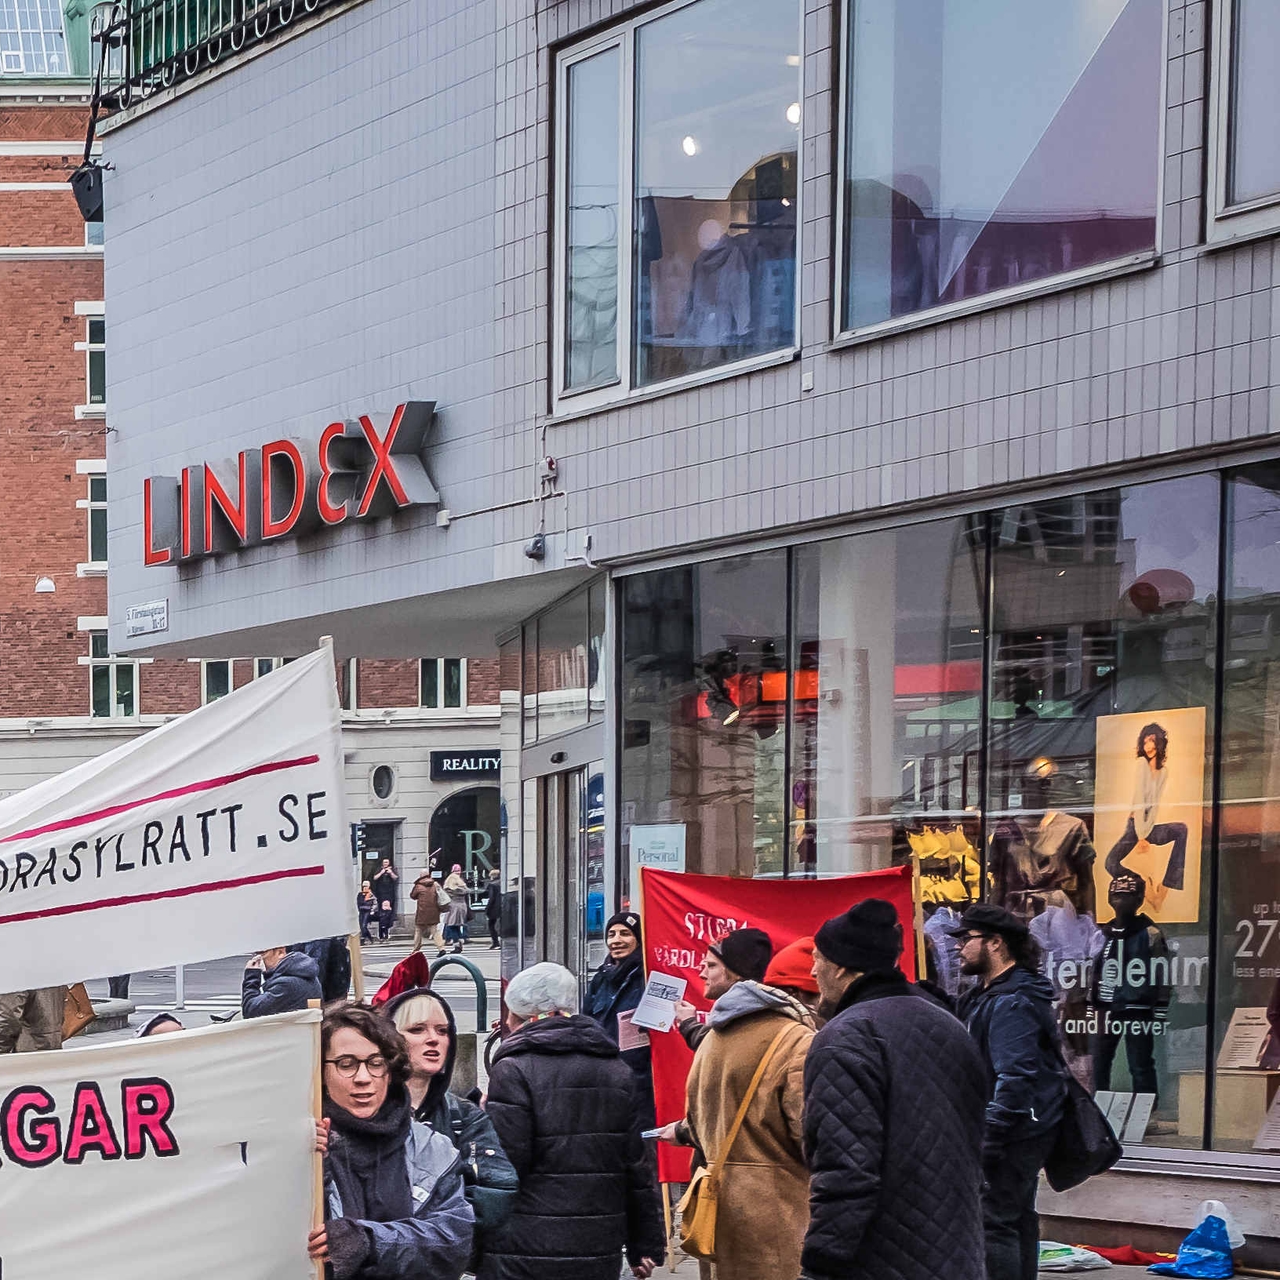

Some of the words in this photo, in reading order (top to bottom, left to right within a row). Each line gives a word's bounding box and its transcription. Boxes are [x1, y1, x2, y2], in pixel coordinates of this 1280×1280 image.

[143, 402, 410, 567] LINDEX
[442, 757, 501, 770] REALITY
[637, 847, 679, 863] Personal
[1253, 904, 1269, 918] up
[1234, 920, 1280, 958] 27
[1102, 939, 1209, 987] denim
[1065, 1010, 1098, 1034] and
[1105, 1010, 1170, 1035] forever
